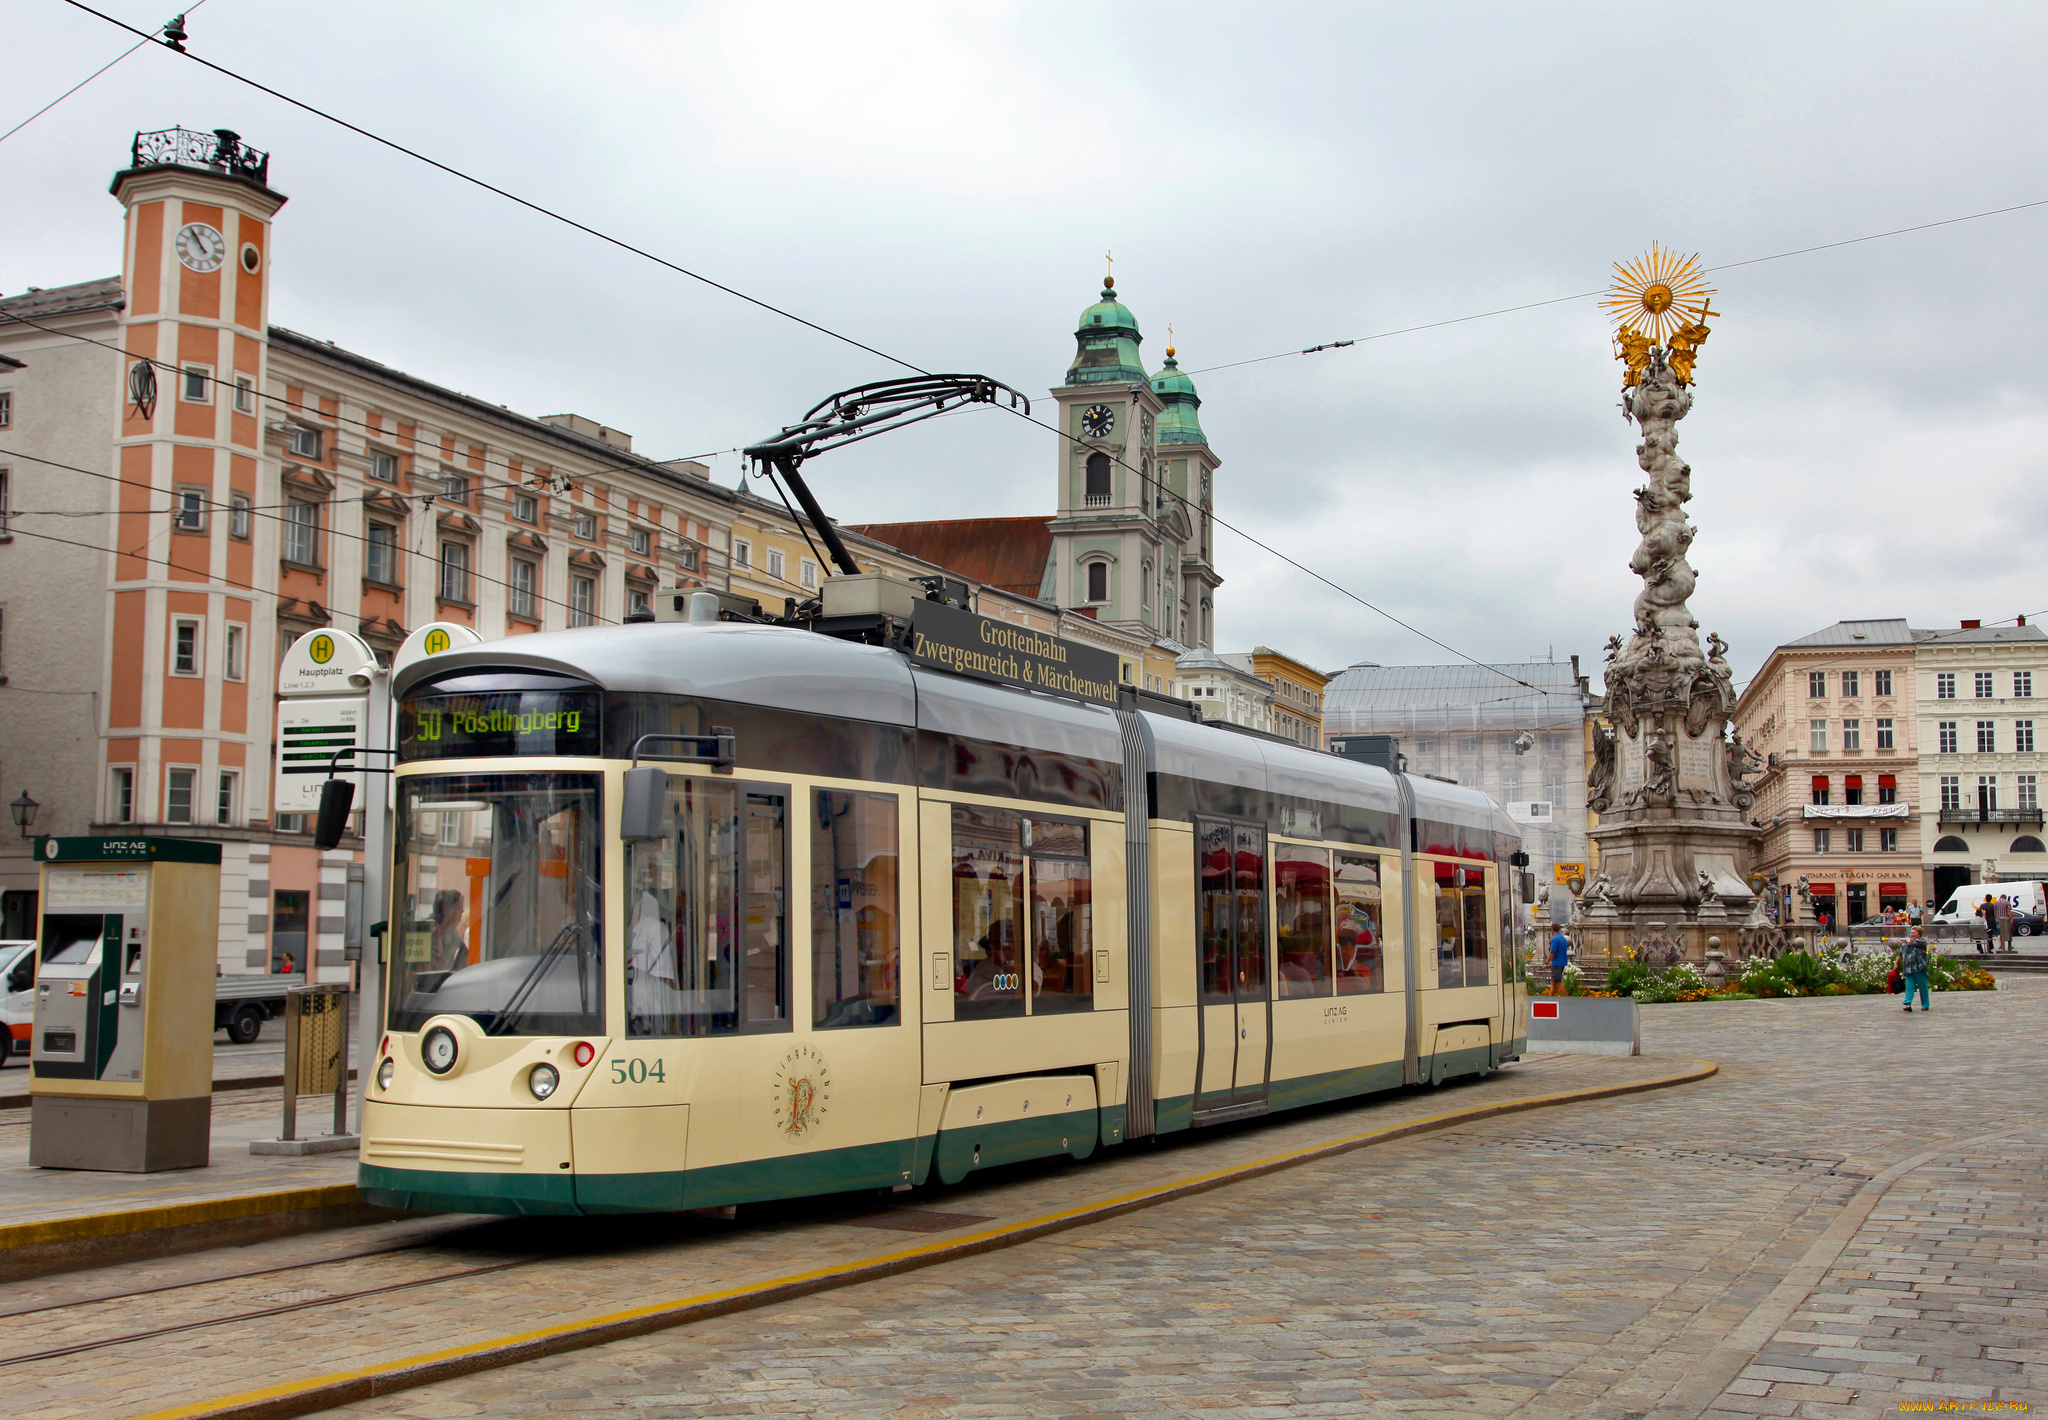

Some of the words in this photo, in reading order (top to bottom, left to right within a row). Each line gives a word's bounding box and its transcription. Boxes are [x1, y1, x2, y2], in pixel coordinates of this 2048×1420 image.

[316, 640, 328, 658] H
[980, 619, 1067, 663] Grottenbahn
[299, 668, 344, 678] Hauptplatz
[915, 632, 1019, 680] Zwergenreich
[1022, 660, 1034, 683] &
[1037, 663, 1118, 703] Märchenwelt
[417, 709, 442, 741] 50
[452, 707, 580, 735] Pöstlingberg
[303, 784, 324, 793] LIN
[103, 841, 128, 849] LINZ
[129, 841, 146, 849] AG
[1338, 1006, 1347, 1015] AG
[611, 1057, 666, 1085] 504
